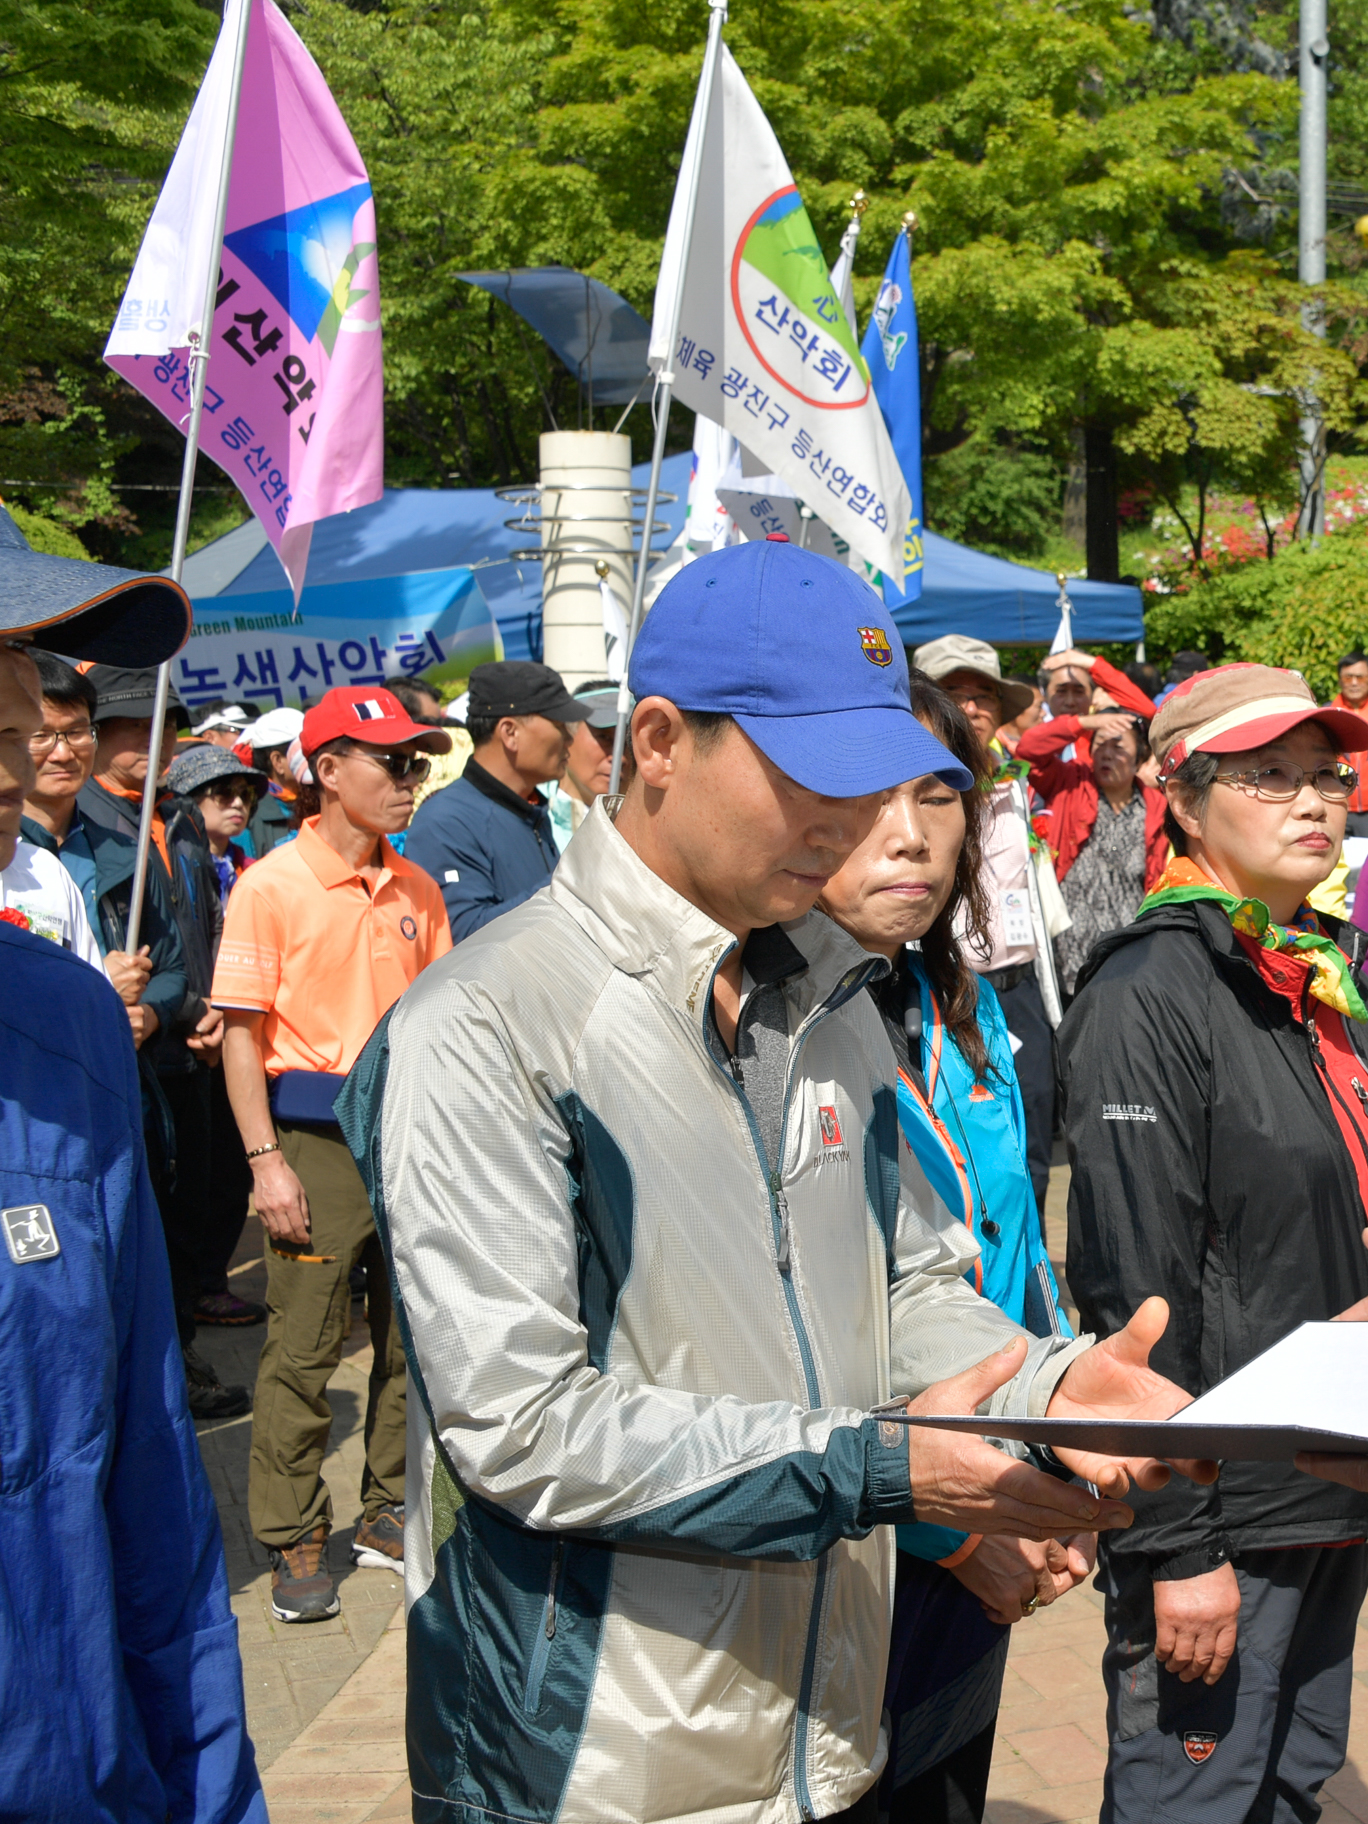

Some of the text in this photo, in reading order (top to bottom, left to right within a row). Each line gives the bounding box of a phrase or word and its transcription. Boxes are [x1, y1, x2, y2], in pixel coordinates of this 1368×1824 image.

[755, 294, 852, 392] 산악회
[720, 367, 790, 431] 광진구
[234, 611, 304, 631] Mountain
[178, 630, 447, 708] 녹색산악회
[242, 956, 255, 966] AU
[1102, 1103, 1142, 1114] MILLET
